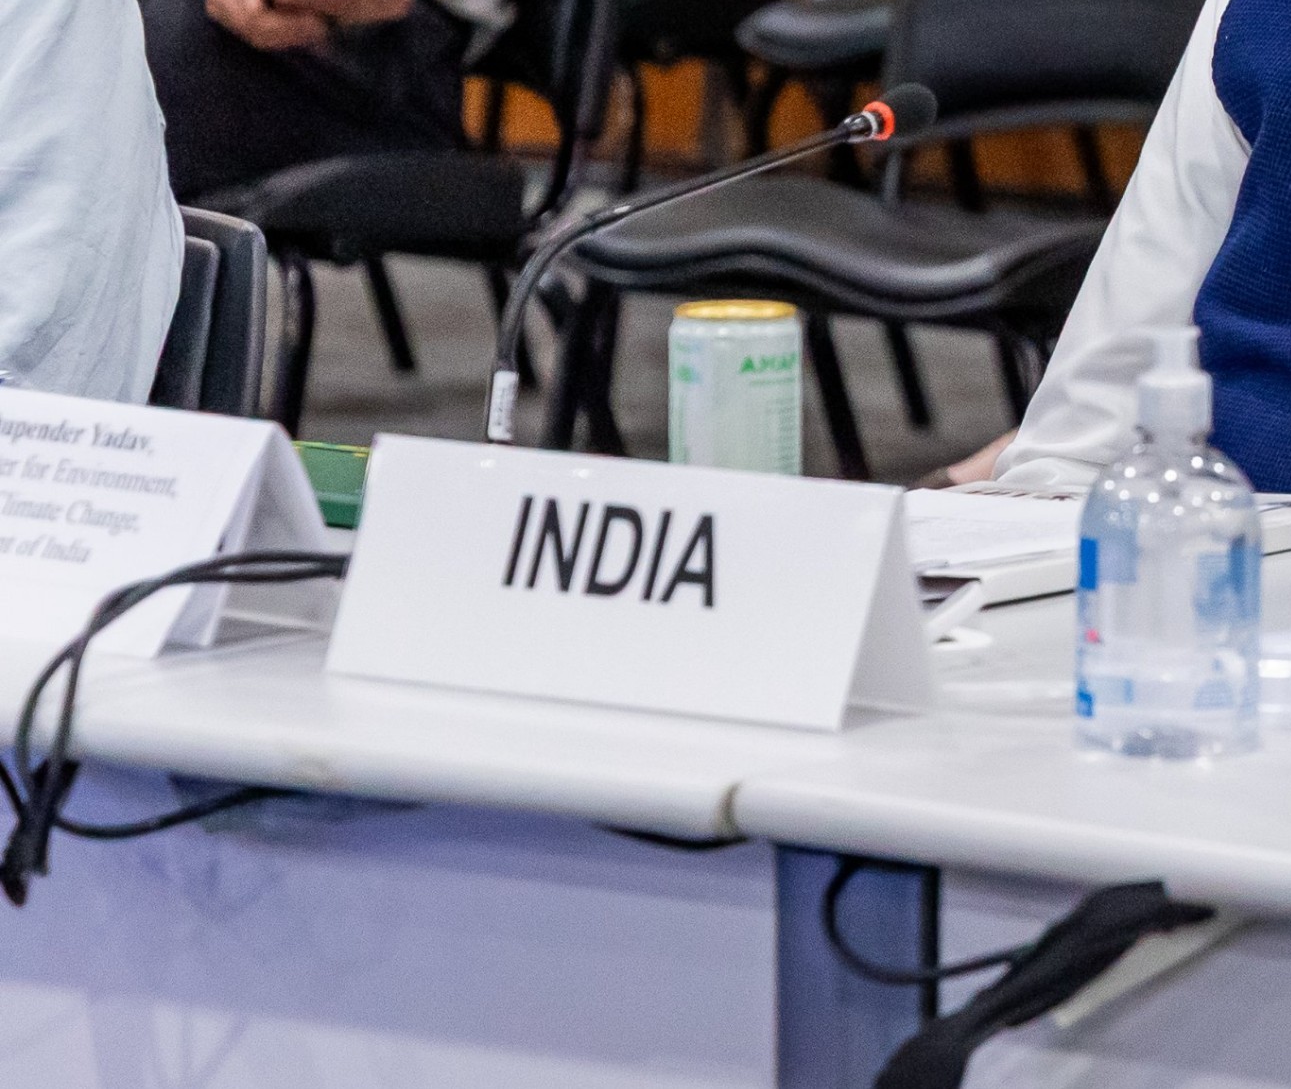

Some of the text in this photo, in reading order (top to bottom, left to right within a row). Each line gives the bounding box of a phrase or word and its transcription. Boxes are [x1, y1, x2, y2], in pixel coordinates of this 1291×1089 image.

[0, 415, 154, 454] upender Yadav,
[20, 454, 50, 480] for
[52, 458, 178, 499] Environment,
[65, 500, 141, 538] Change,
[15, 534, 46, 558] of
[40, 537, 92, 565] India
[502, 495, 714, 607] INDIA
